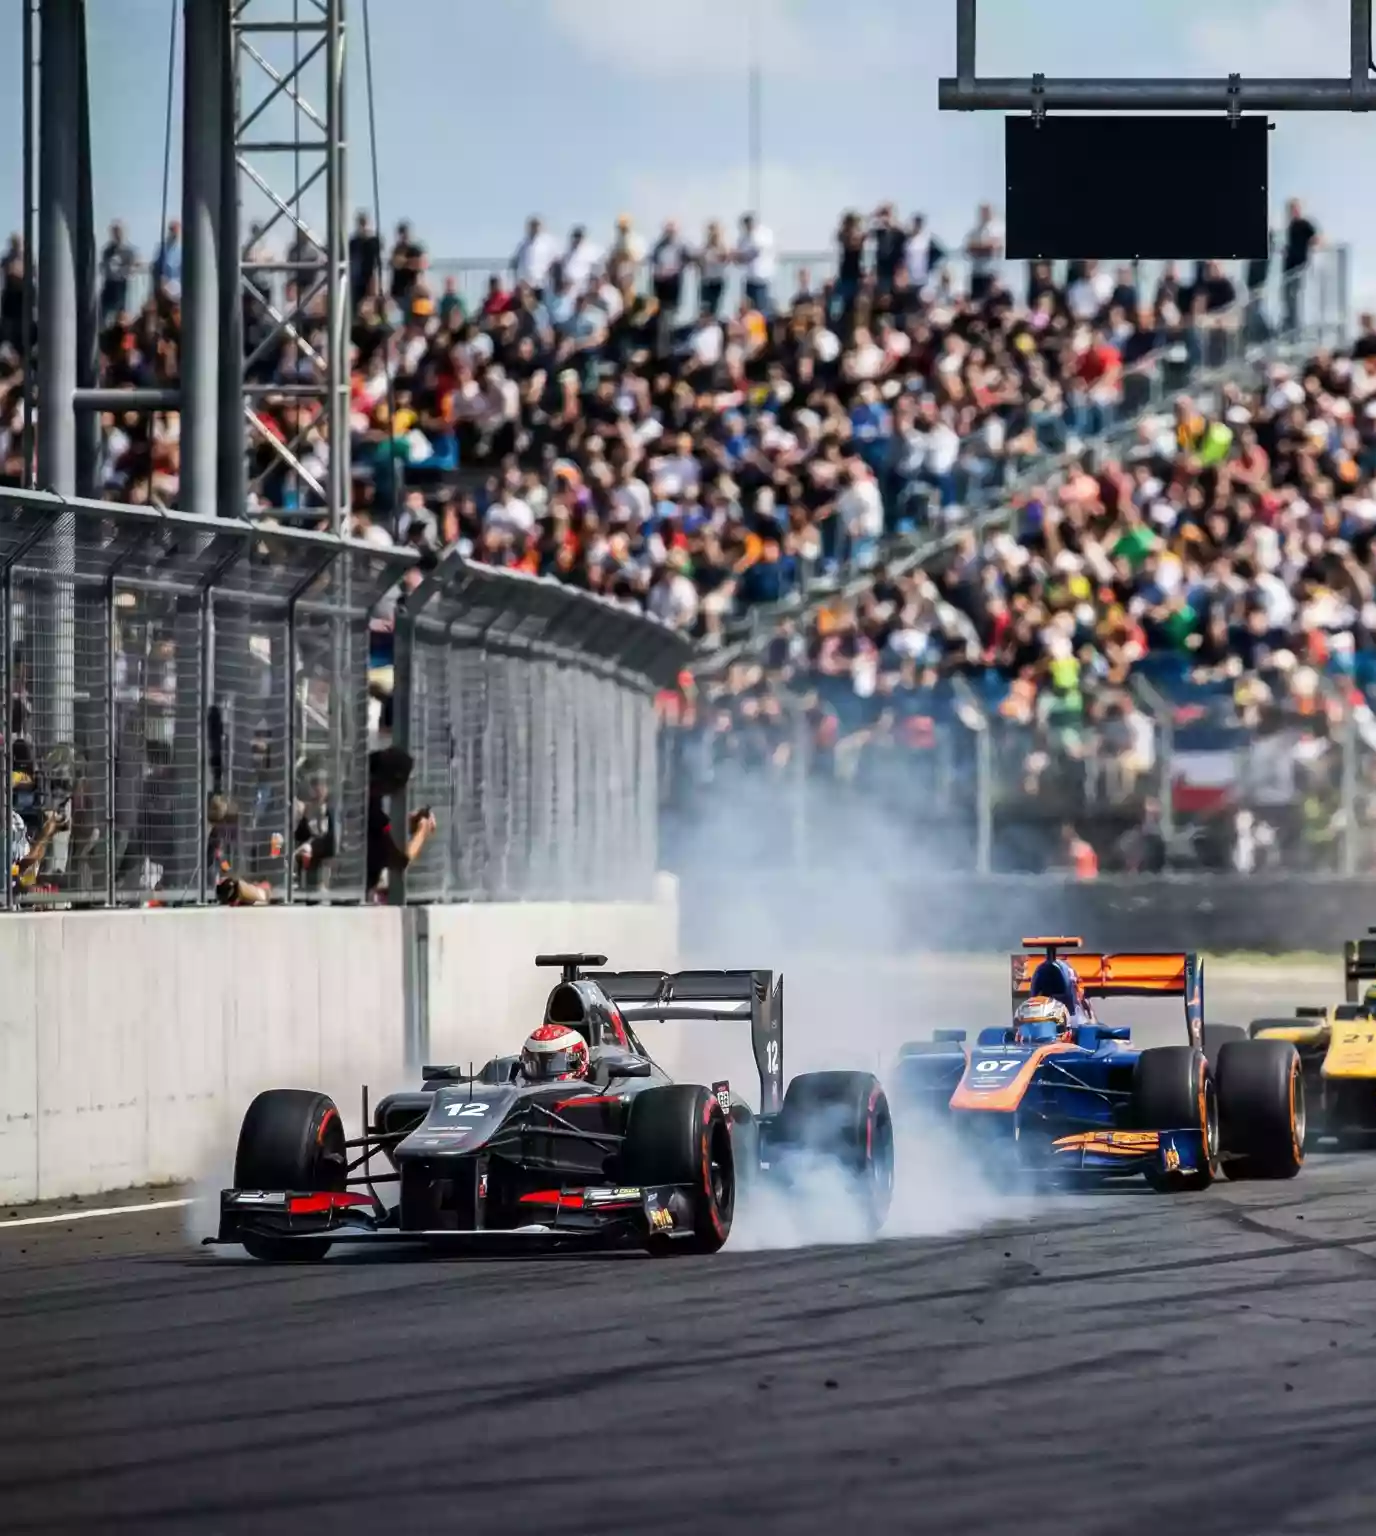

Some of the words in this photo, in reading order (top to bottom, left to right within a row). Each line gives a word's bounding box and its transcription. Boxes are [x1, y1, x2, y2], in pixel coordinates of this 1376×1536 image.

[1342, 1033, 1375, 1043] 21
[766, 1040, 779, 1075] 12
[976, 1060, 1022, 1072] 07
[444, 1102, 490, 1117] 12
